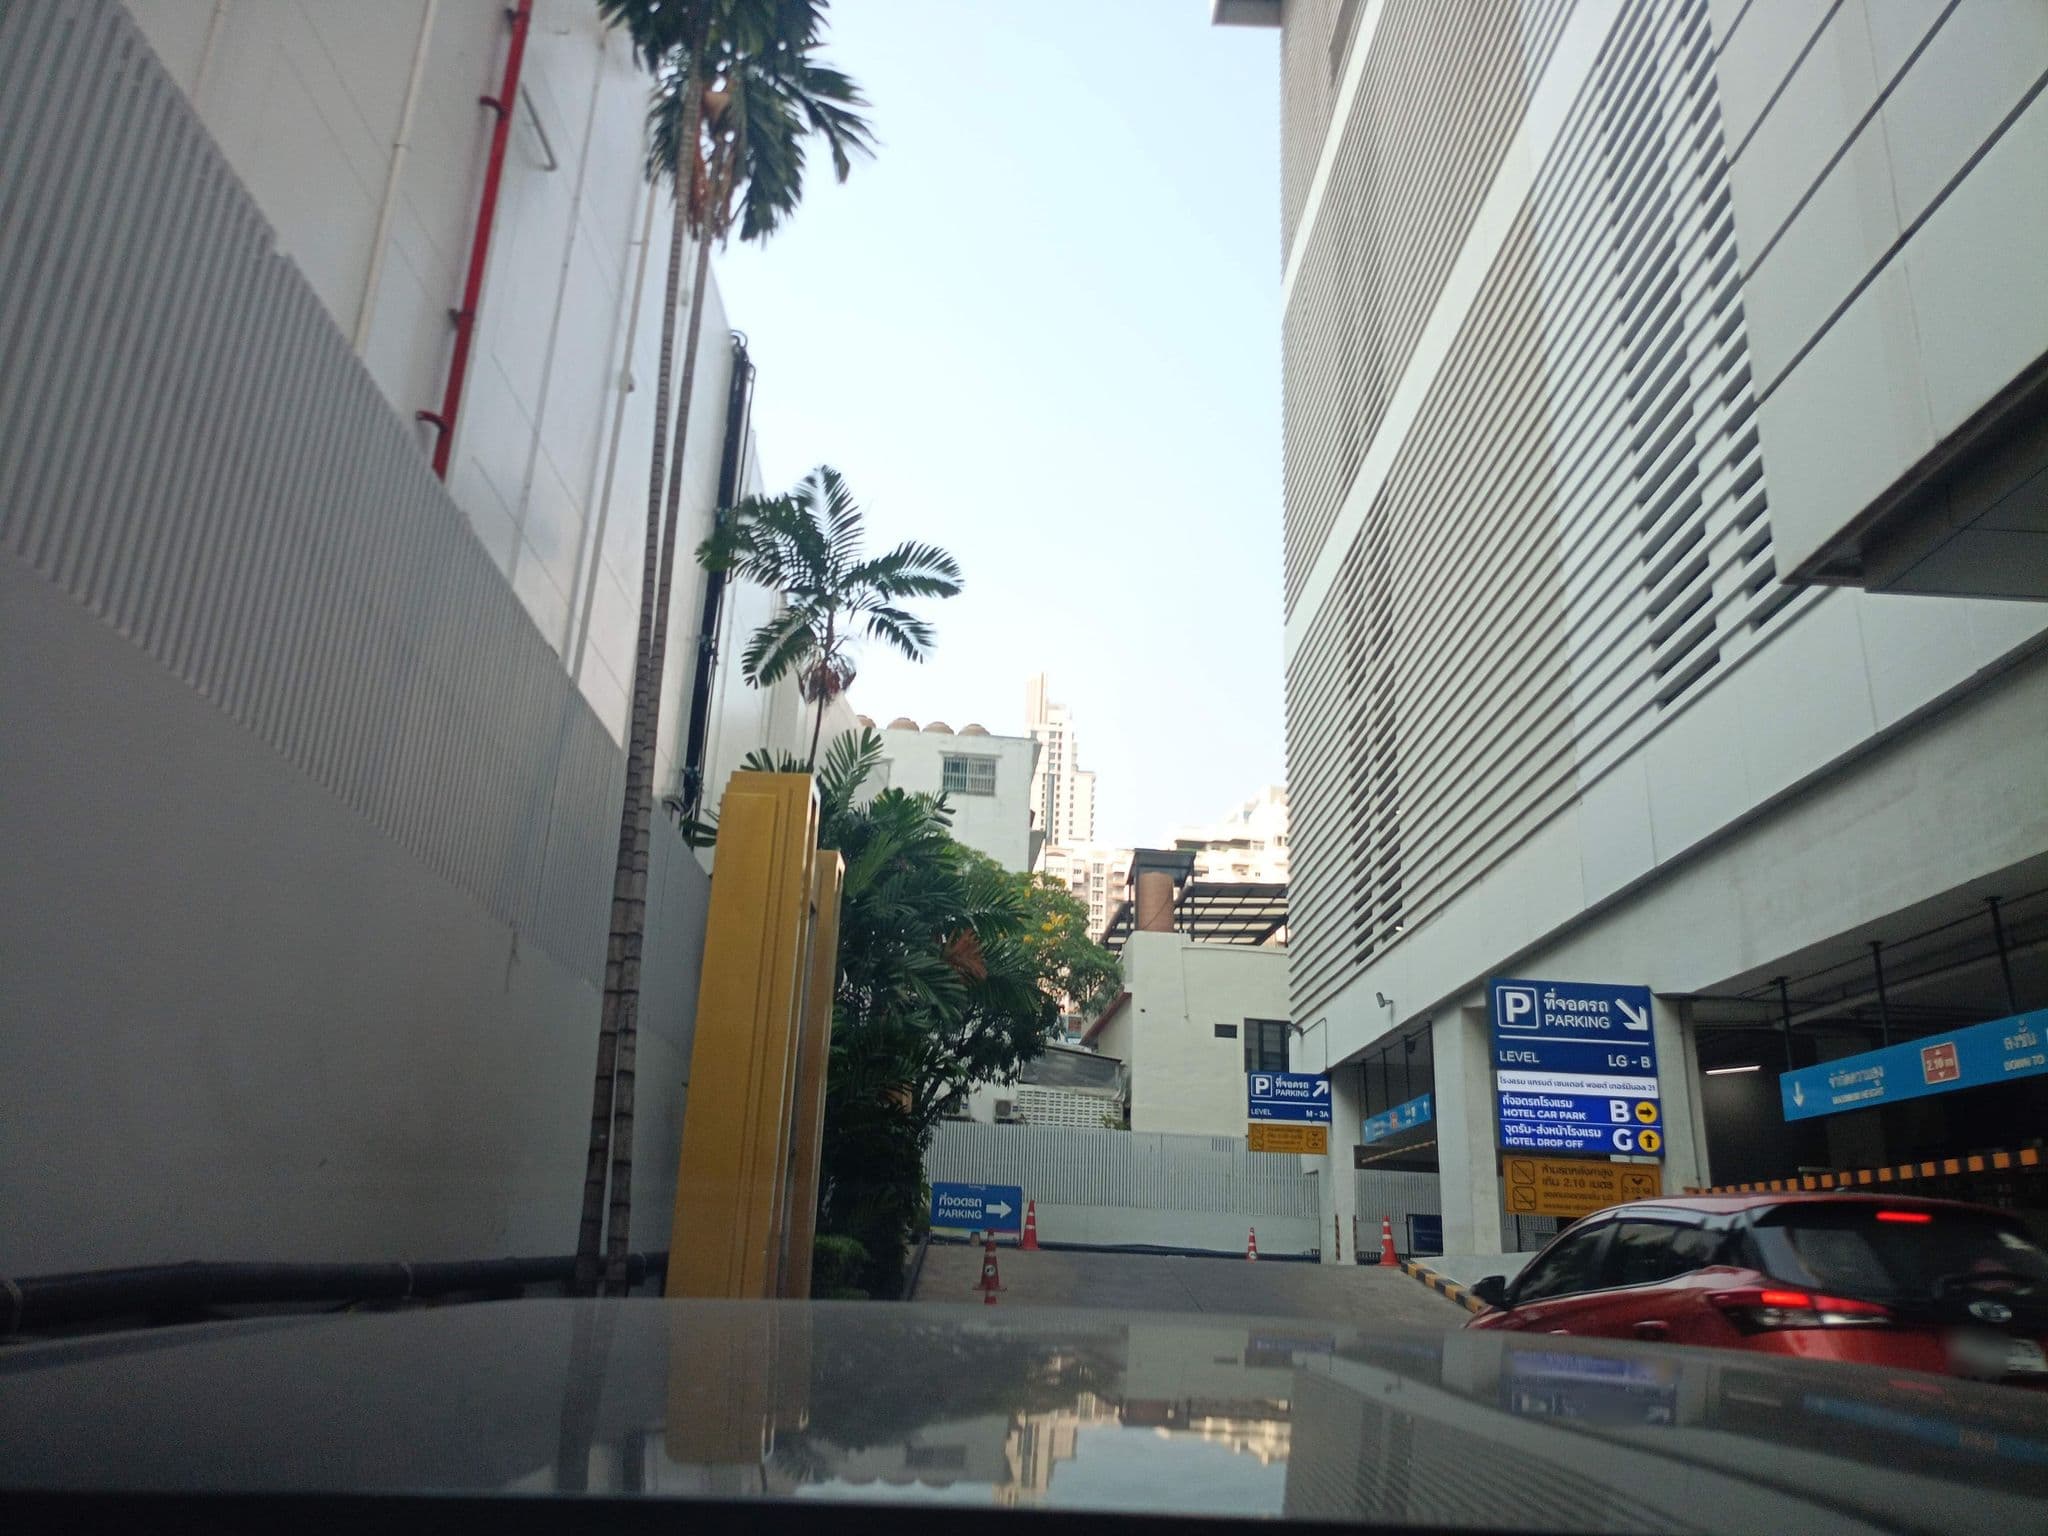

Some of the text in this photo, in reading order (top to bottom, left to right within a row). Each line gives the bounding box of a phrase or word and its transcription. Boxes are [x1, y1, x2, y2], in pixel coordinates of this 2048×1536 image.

[1505, 992, 1531, 1023] P
[1544, 988, 1609, 1013] ที่จอดรถ
[1545, 1014, 1610, 1029] PARKING
[1500, 1050, 1540, 1064] LEVEL
[1608, 1054, 1628, 1067] LG
[1641, 1056, 1651, 1068] B
[1255, 1077, 1269, 1095] P
[1275, 1075, 1309, 1089] ที่จอดรถ
[1648, 1084, 1656, 1092] 21
[1275, 1090, 1309, 1098] PARKING
[1503, 1092, 1573, 1108] ที่จอดรถโรงแรม
[1251, 1108, 1272, 1116] LEVEL
[1319, 1110, 1329, 1118] 3A
[1503, 1108, 1586, 1120] HOTEL CAR PARK
[1609, 1100, 1630, 1123] B
[1505, 1137, 1584, 1148] HOTEL DROP OFF
[1612, 1128, 1633, 1151] G
[939, 1192, 982, 1207] ที่จอดรถ
[938, 1208, 983, 1219] PARKING
